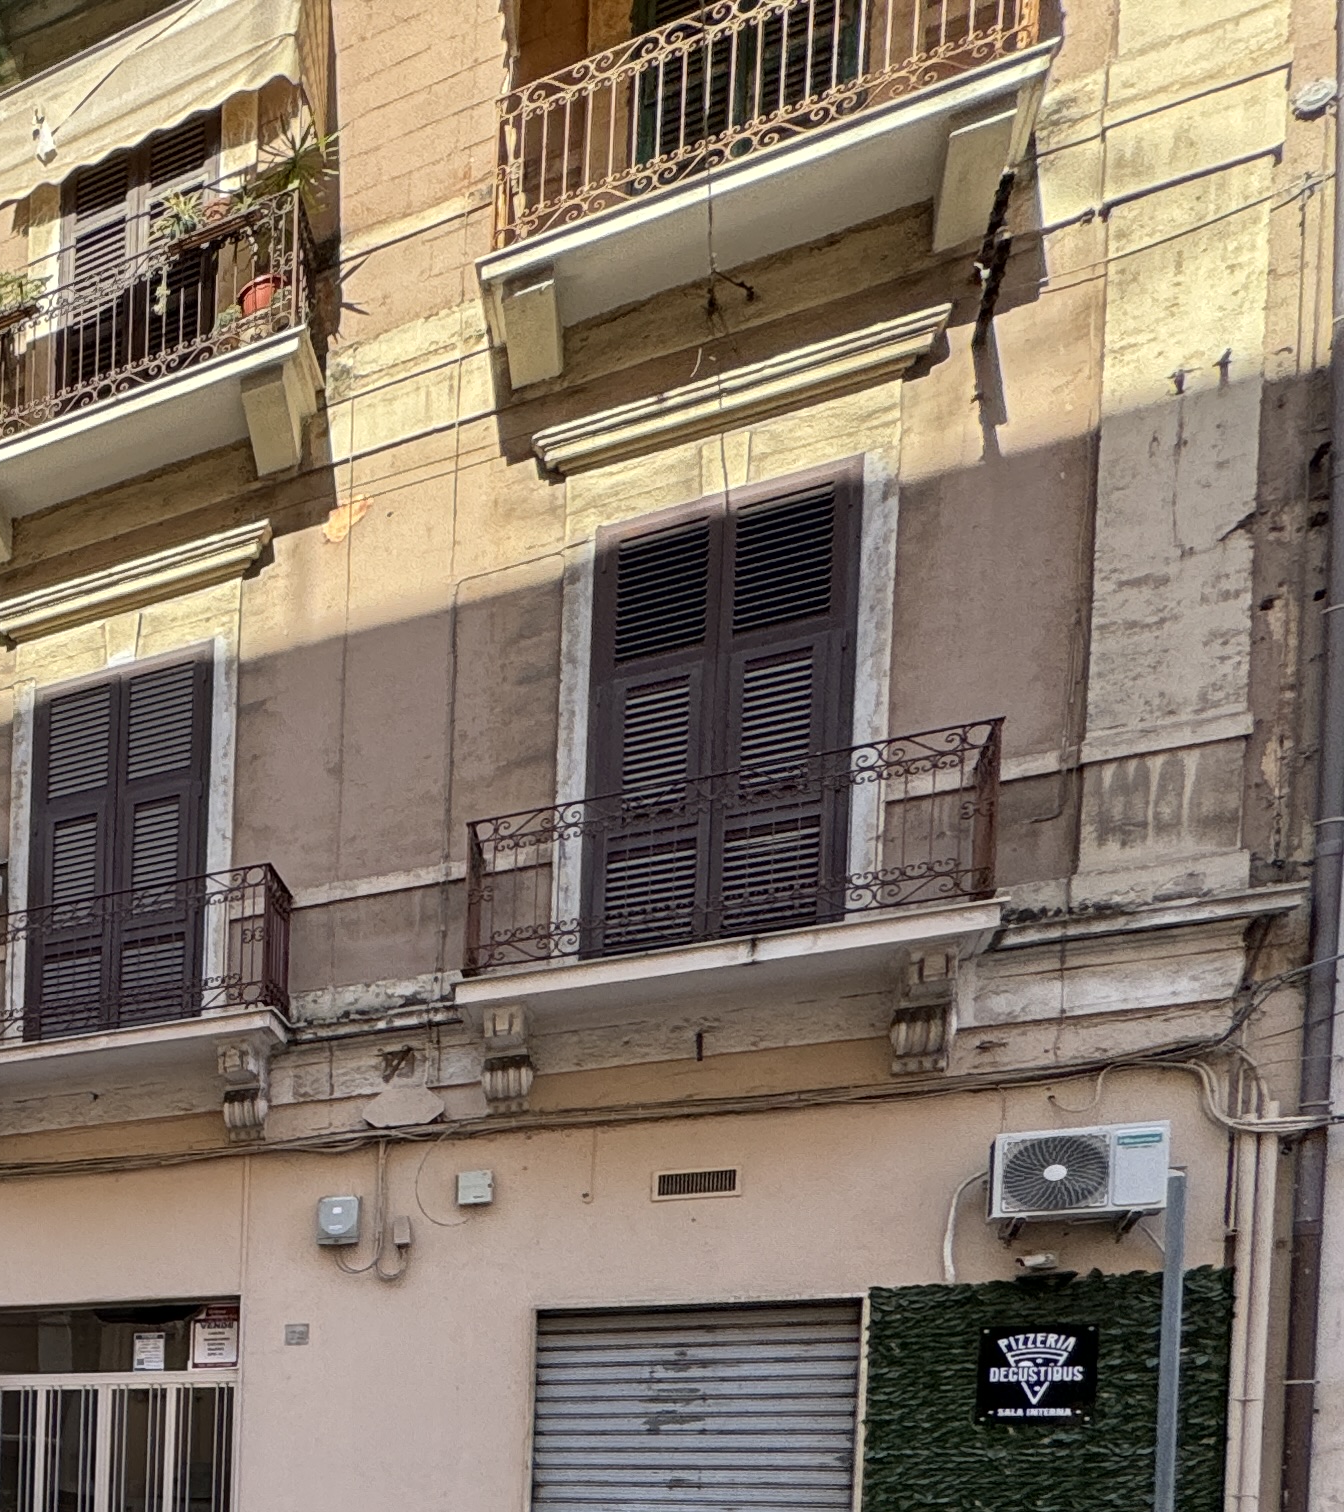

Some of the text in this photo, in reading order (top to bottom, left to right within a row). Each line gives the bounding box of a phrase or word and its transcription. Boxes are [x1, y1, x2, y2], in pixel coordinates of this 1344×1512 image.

[997, 1333, 1077, 1353] PIZZERIA
[989, 1365, 1084, 1382] DEGUSTIBUS
[997, 1407, 1072, 1417] SALA INTERNA
